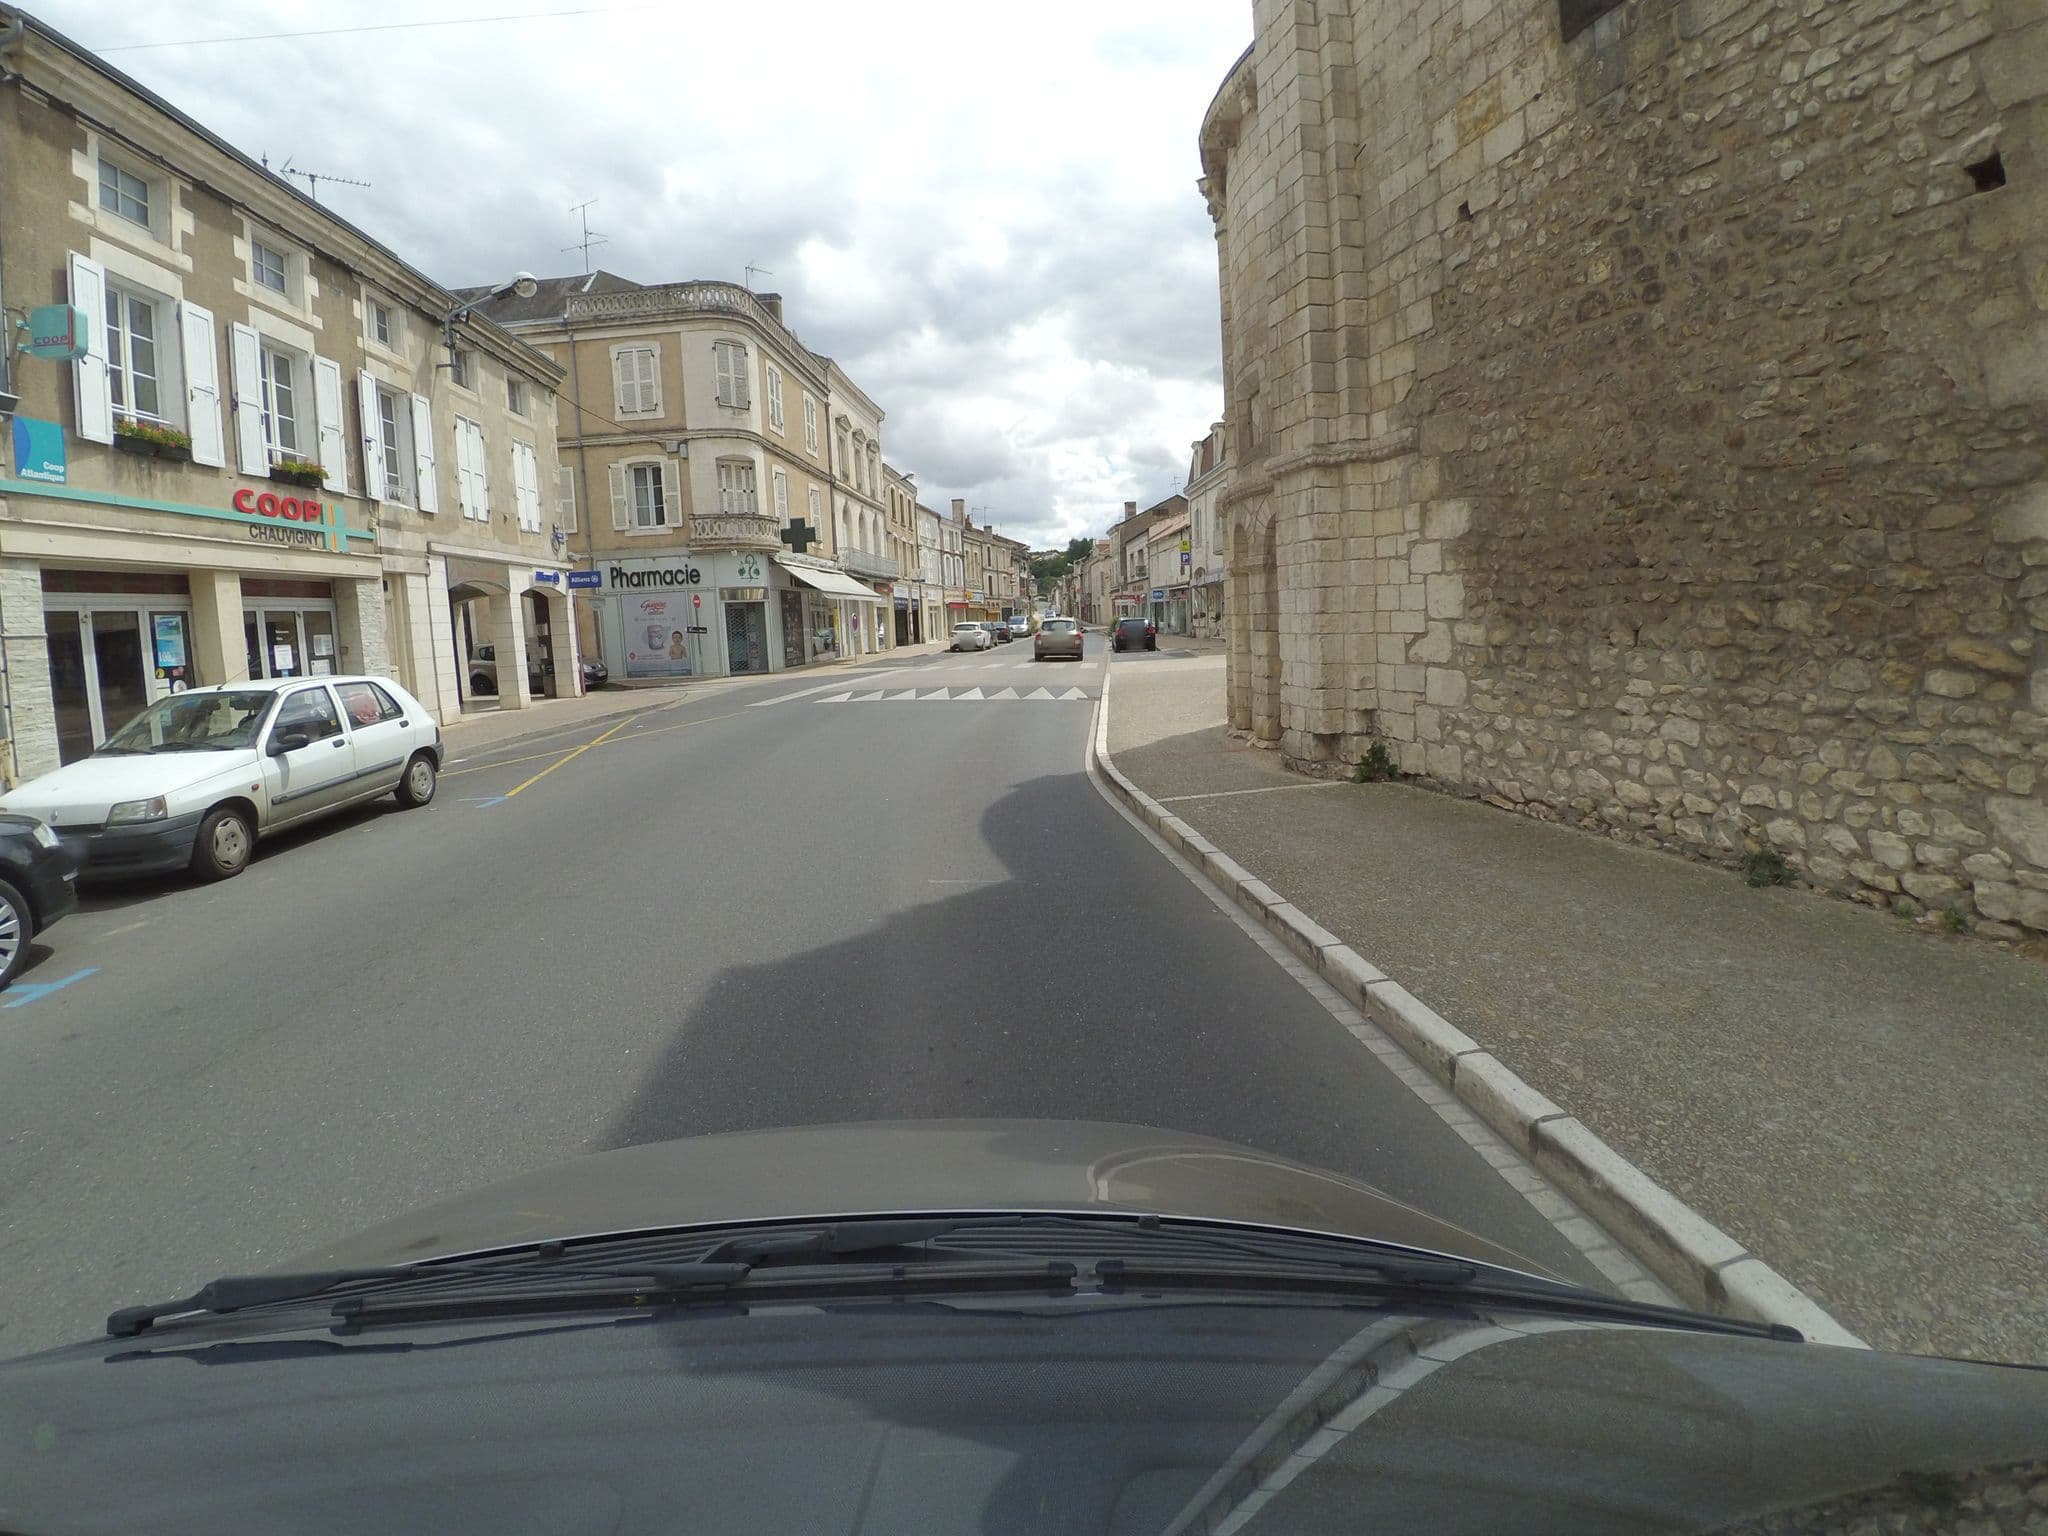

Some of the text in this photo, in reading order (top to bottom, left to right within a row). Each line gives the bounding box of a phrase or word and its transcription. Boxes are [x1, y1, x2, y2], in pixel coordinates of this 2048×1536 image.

[34, 335, 68, 345] COOP
[21, 468, 65, 482] Atlantique
[43, 461, 65, 473] Coop
[233, 488, 322, 522] COOP
[249, 524, 319, 546] CHAUVIGNY
[610, 563, 701, 589] Pharmacie
